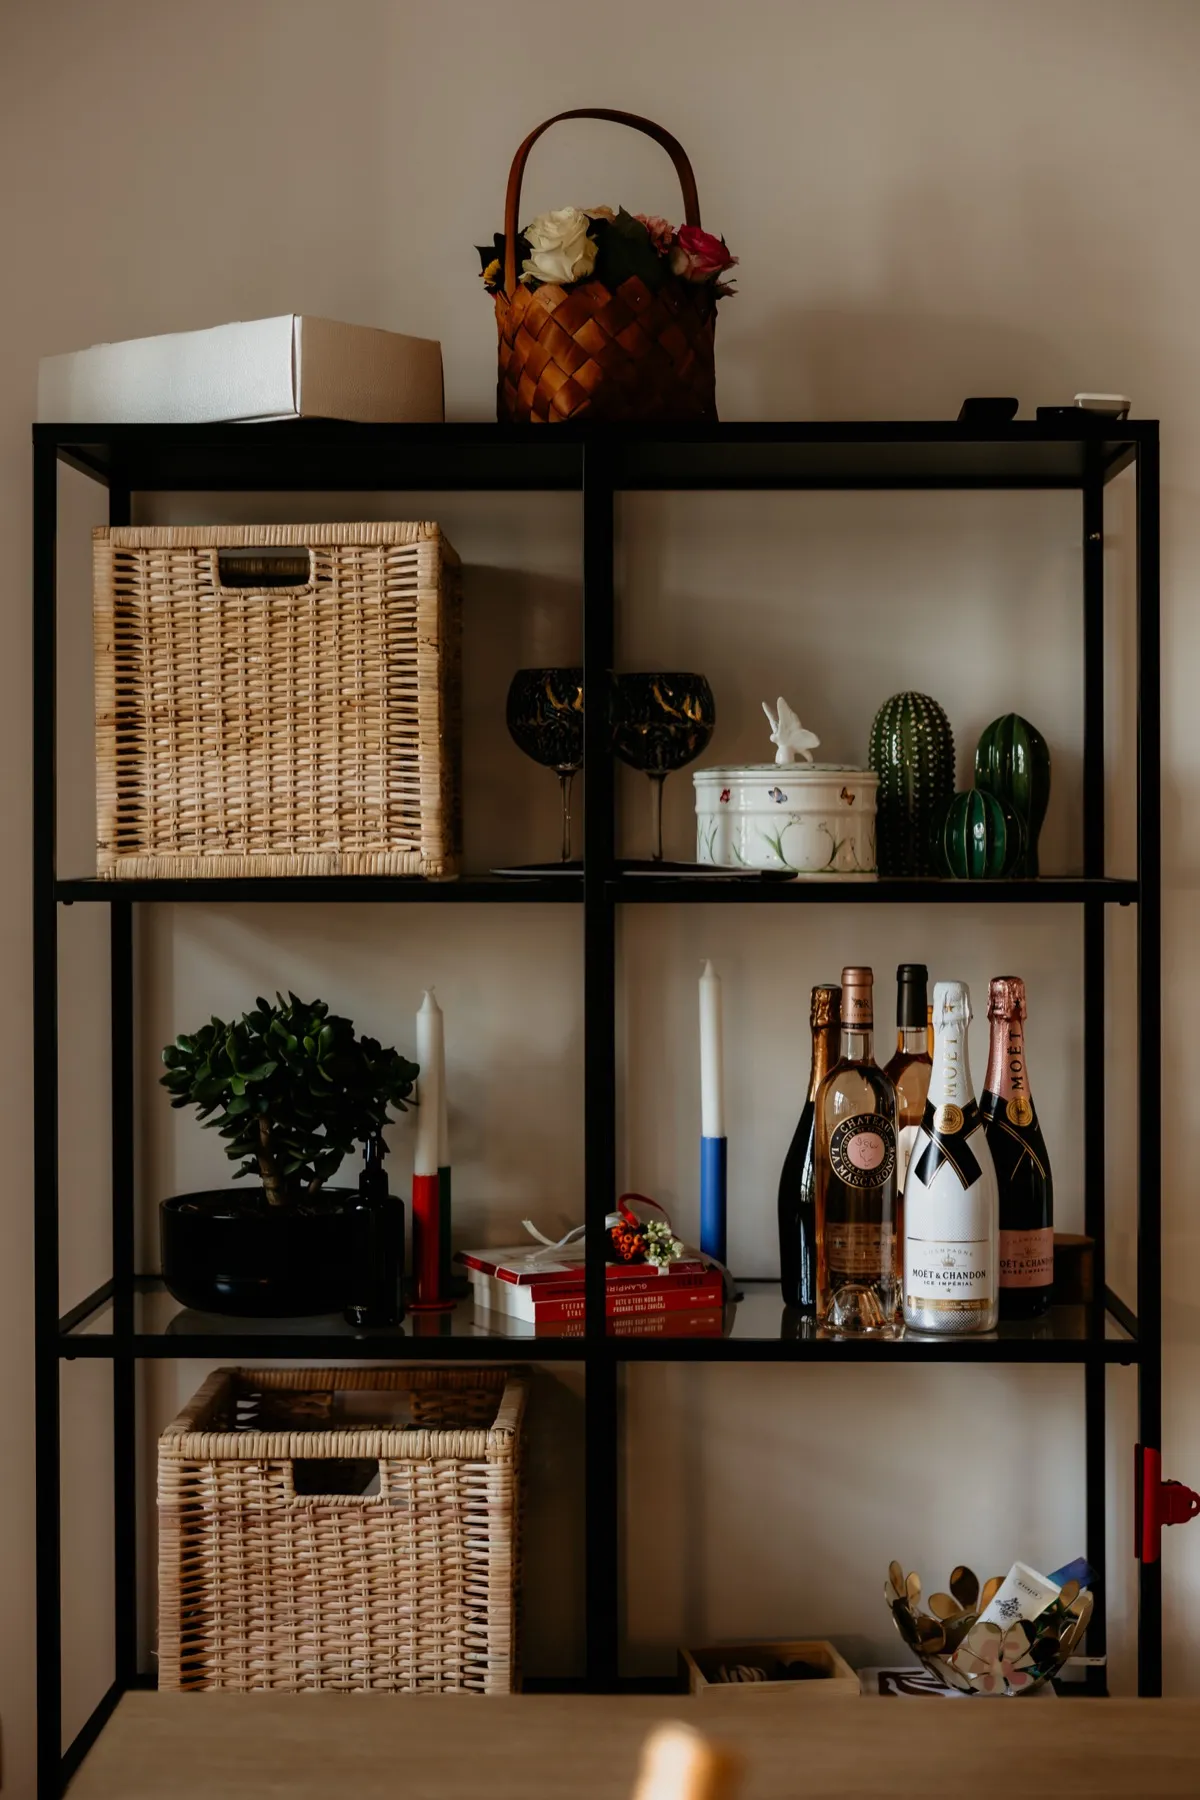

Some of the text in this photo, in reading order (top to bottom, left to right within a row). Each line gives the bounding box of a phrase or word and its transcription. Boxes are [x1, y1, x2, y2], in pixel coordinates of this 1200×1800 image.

[1007, 1030, 1024, 1090] MOËT
[831, 1147, 840, 1164] LA
[836, 1146, 895, 1187] MASCARONNE
[912, 1268, 934, 1279] MOËT
[942, 1270, 986, 1280] CHANDON
